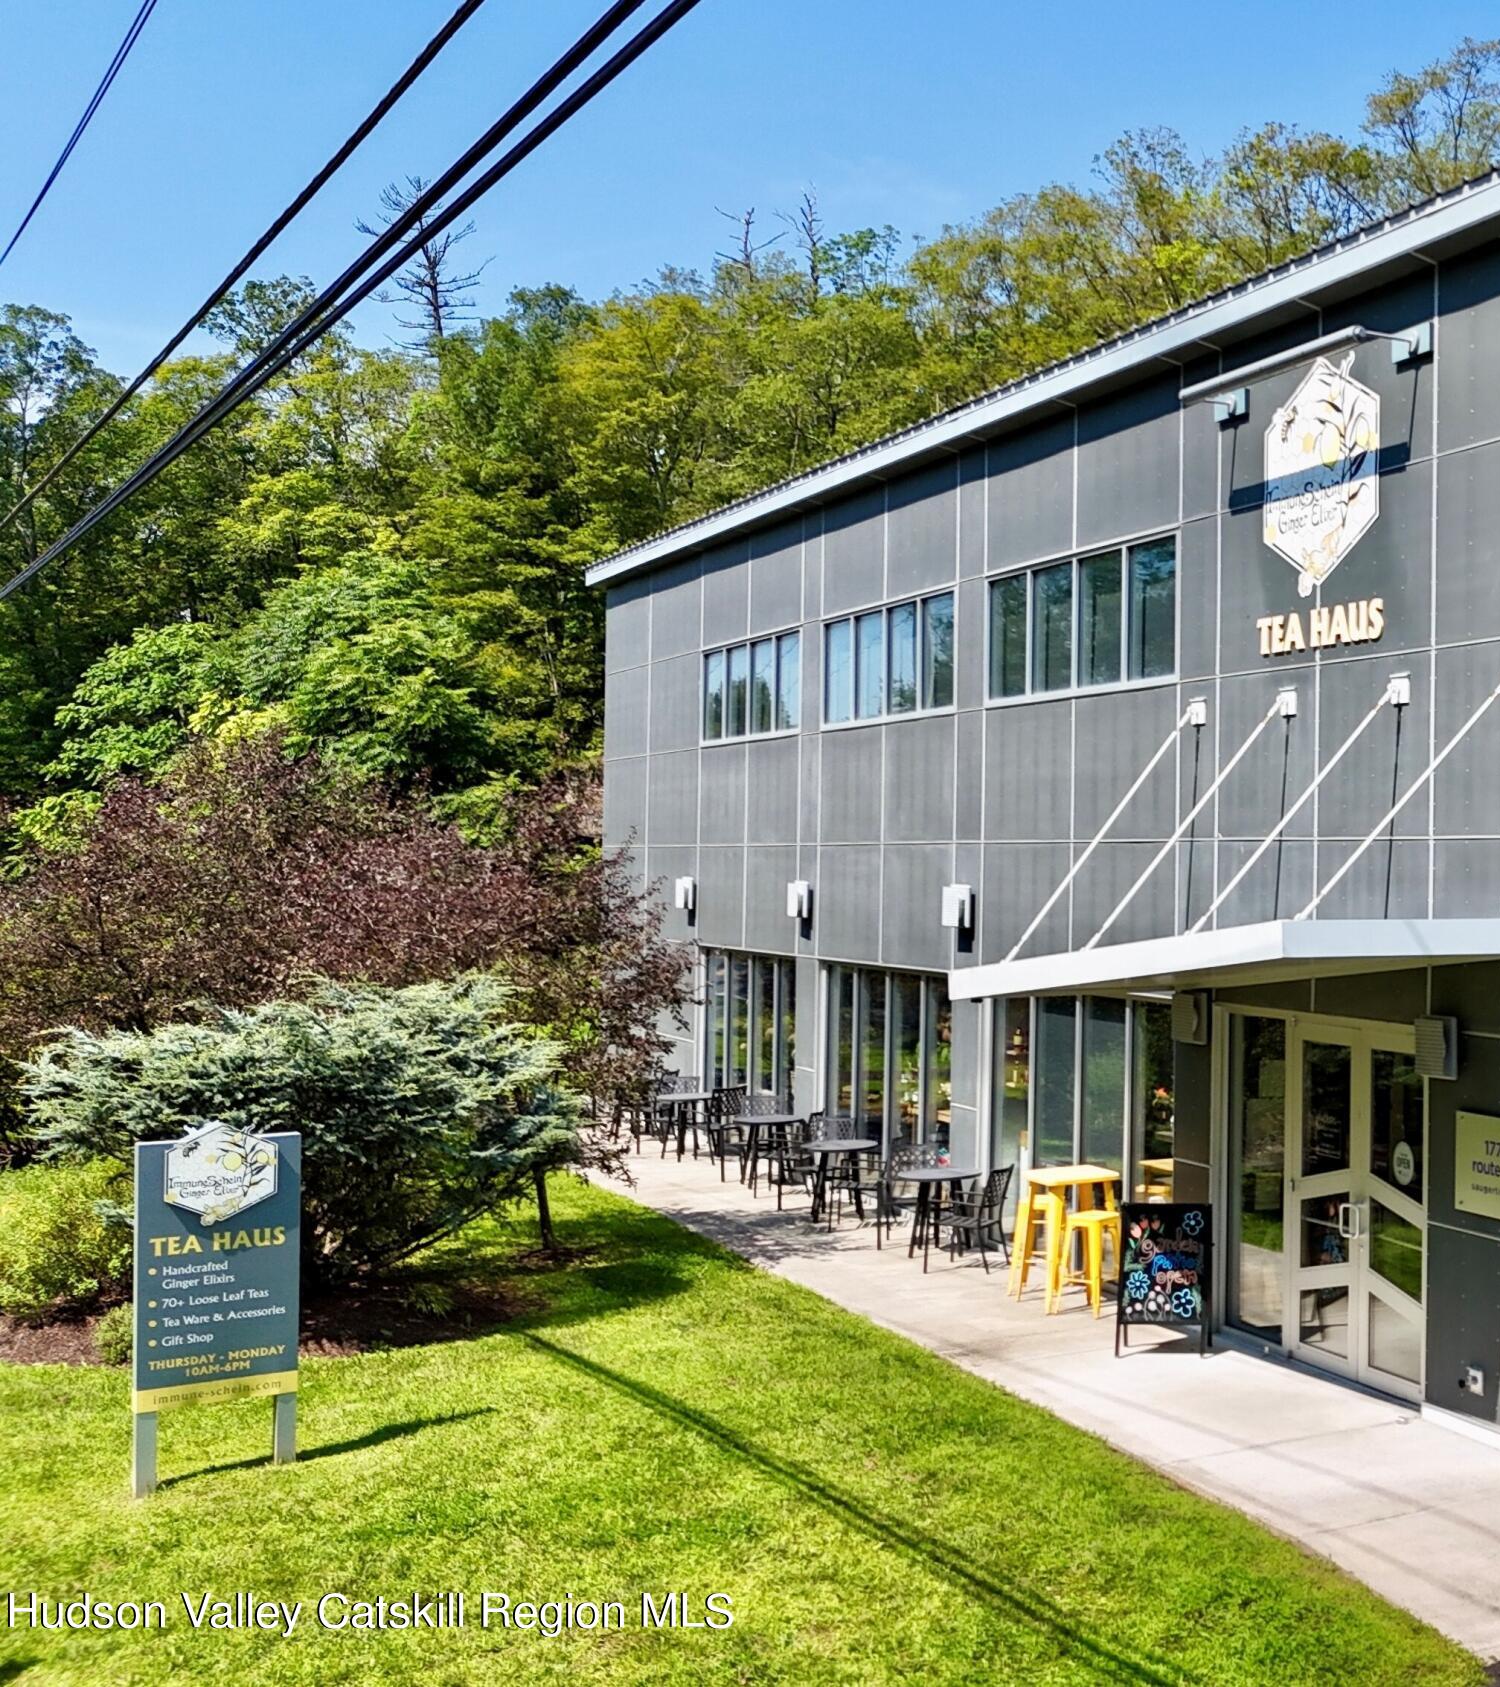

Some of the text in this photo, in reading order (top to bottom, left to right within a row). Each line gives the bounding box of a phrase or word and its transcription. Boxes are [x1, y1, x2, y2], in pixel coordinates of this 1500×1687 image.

[1256, 598, 1384, 656] TEA HAUS
[1472, 1160, 1500, 1178] route
[149, 1226, 286, 1257] TEA HAUS
[162, 1261, 229, 1277] Handcrafted
[162, 1274, 236, 1290] Ginger Elixirs
[1156, 1269, 1198, 1295] open
[162, 1288, 270, 1309] 70+ Loose Leaf Teas
[162, 1305, 286, 1328] Tea Ware & Accessories
[161, 1333, 214, 1347] Gift Shop
[148, 1353, 217, 1371] THURSDAY
[228, 1345, 286, 1360] MONDAY
[185, 1360, 251, 1377] 10AM-6PM
[153, 1381, 282, 1405] immune-schein.com
